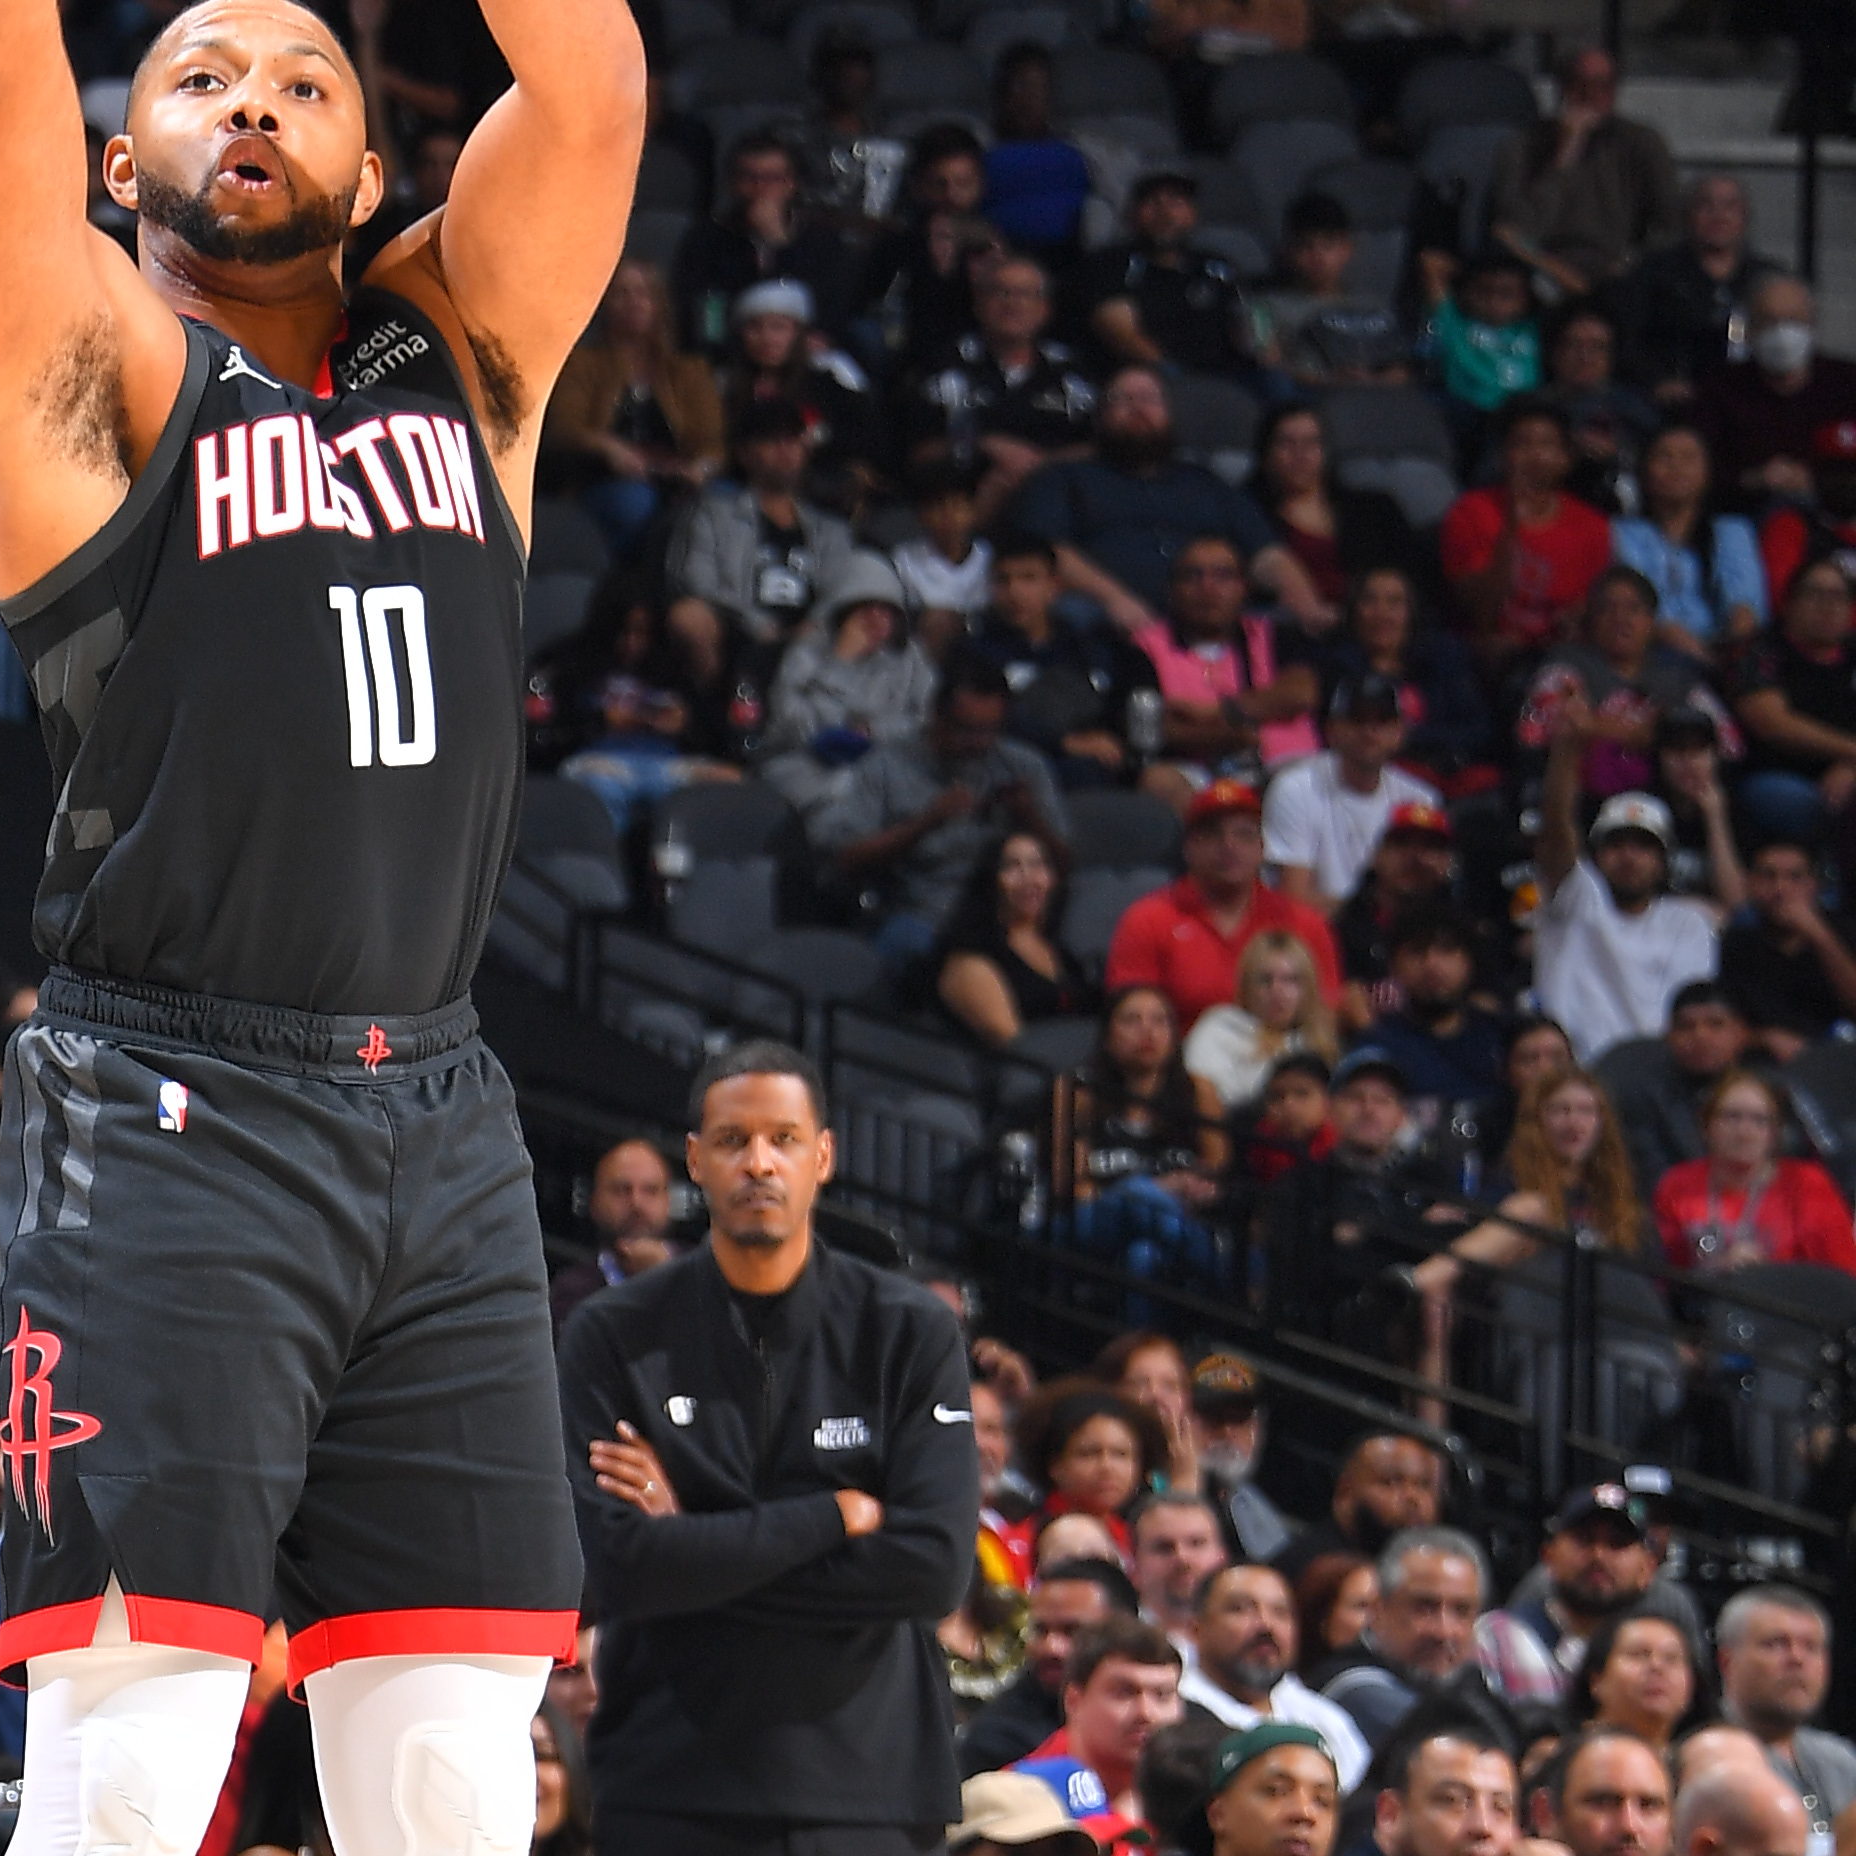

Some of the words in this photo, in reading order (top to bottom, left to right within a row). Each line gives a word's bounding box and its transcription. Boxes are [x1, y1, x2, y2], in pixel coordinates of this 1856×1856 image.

[338, 319, 408, 378] credit
[194, 412, 486, 562] HOUSTON
[328, 583, 437, 769] 10
